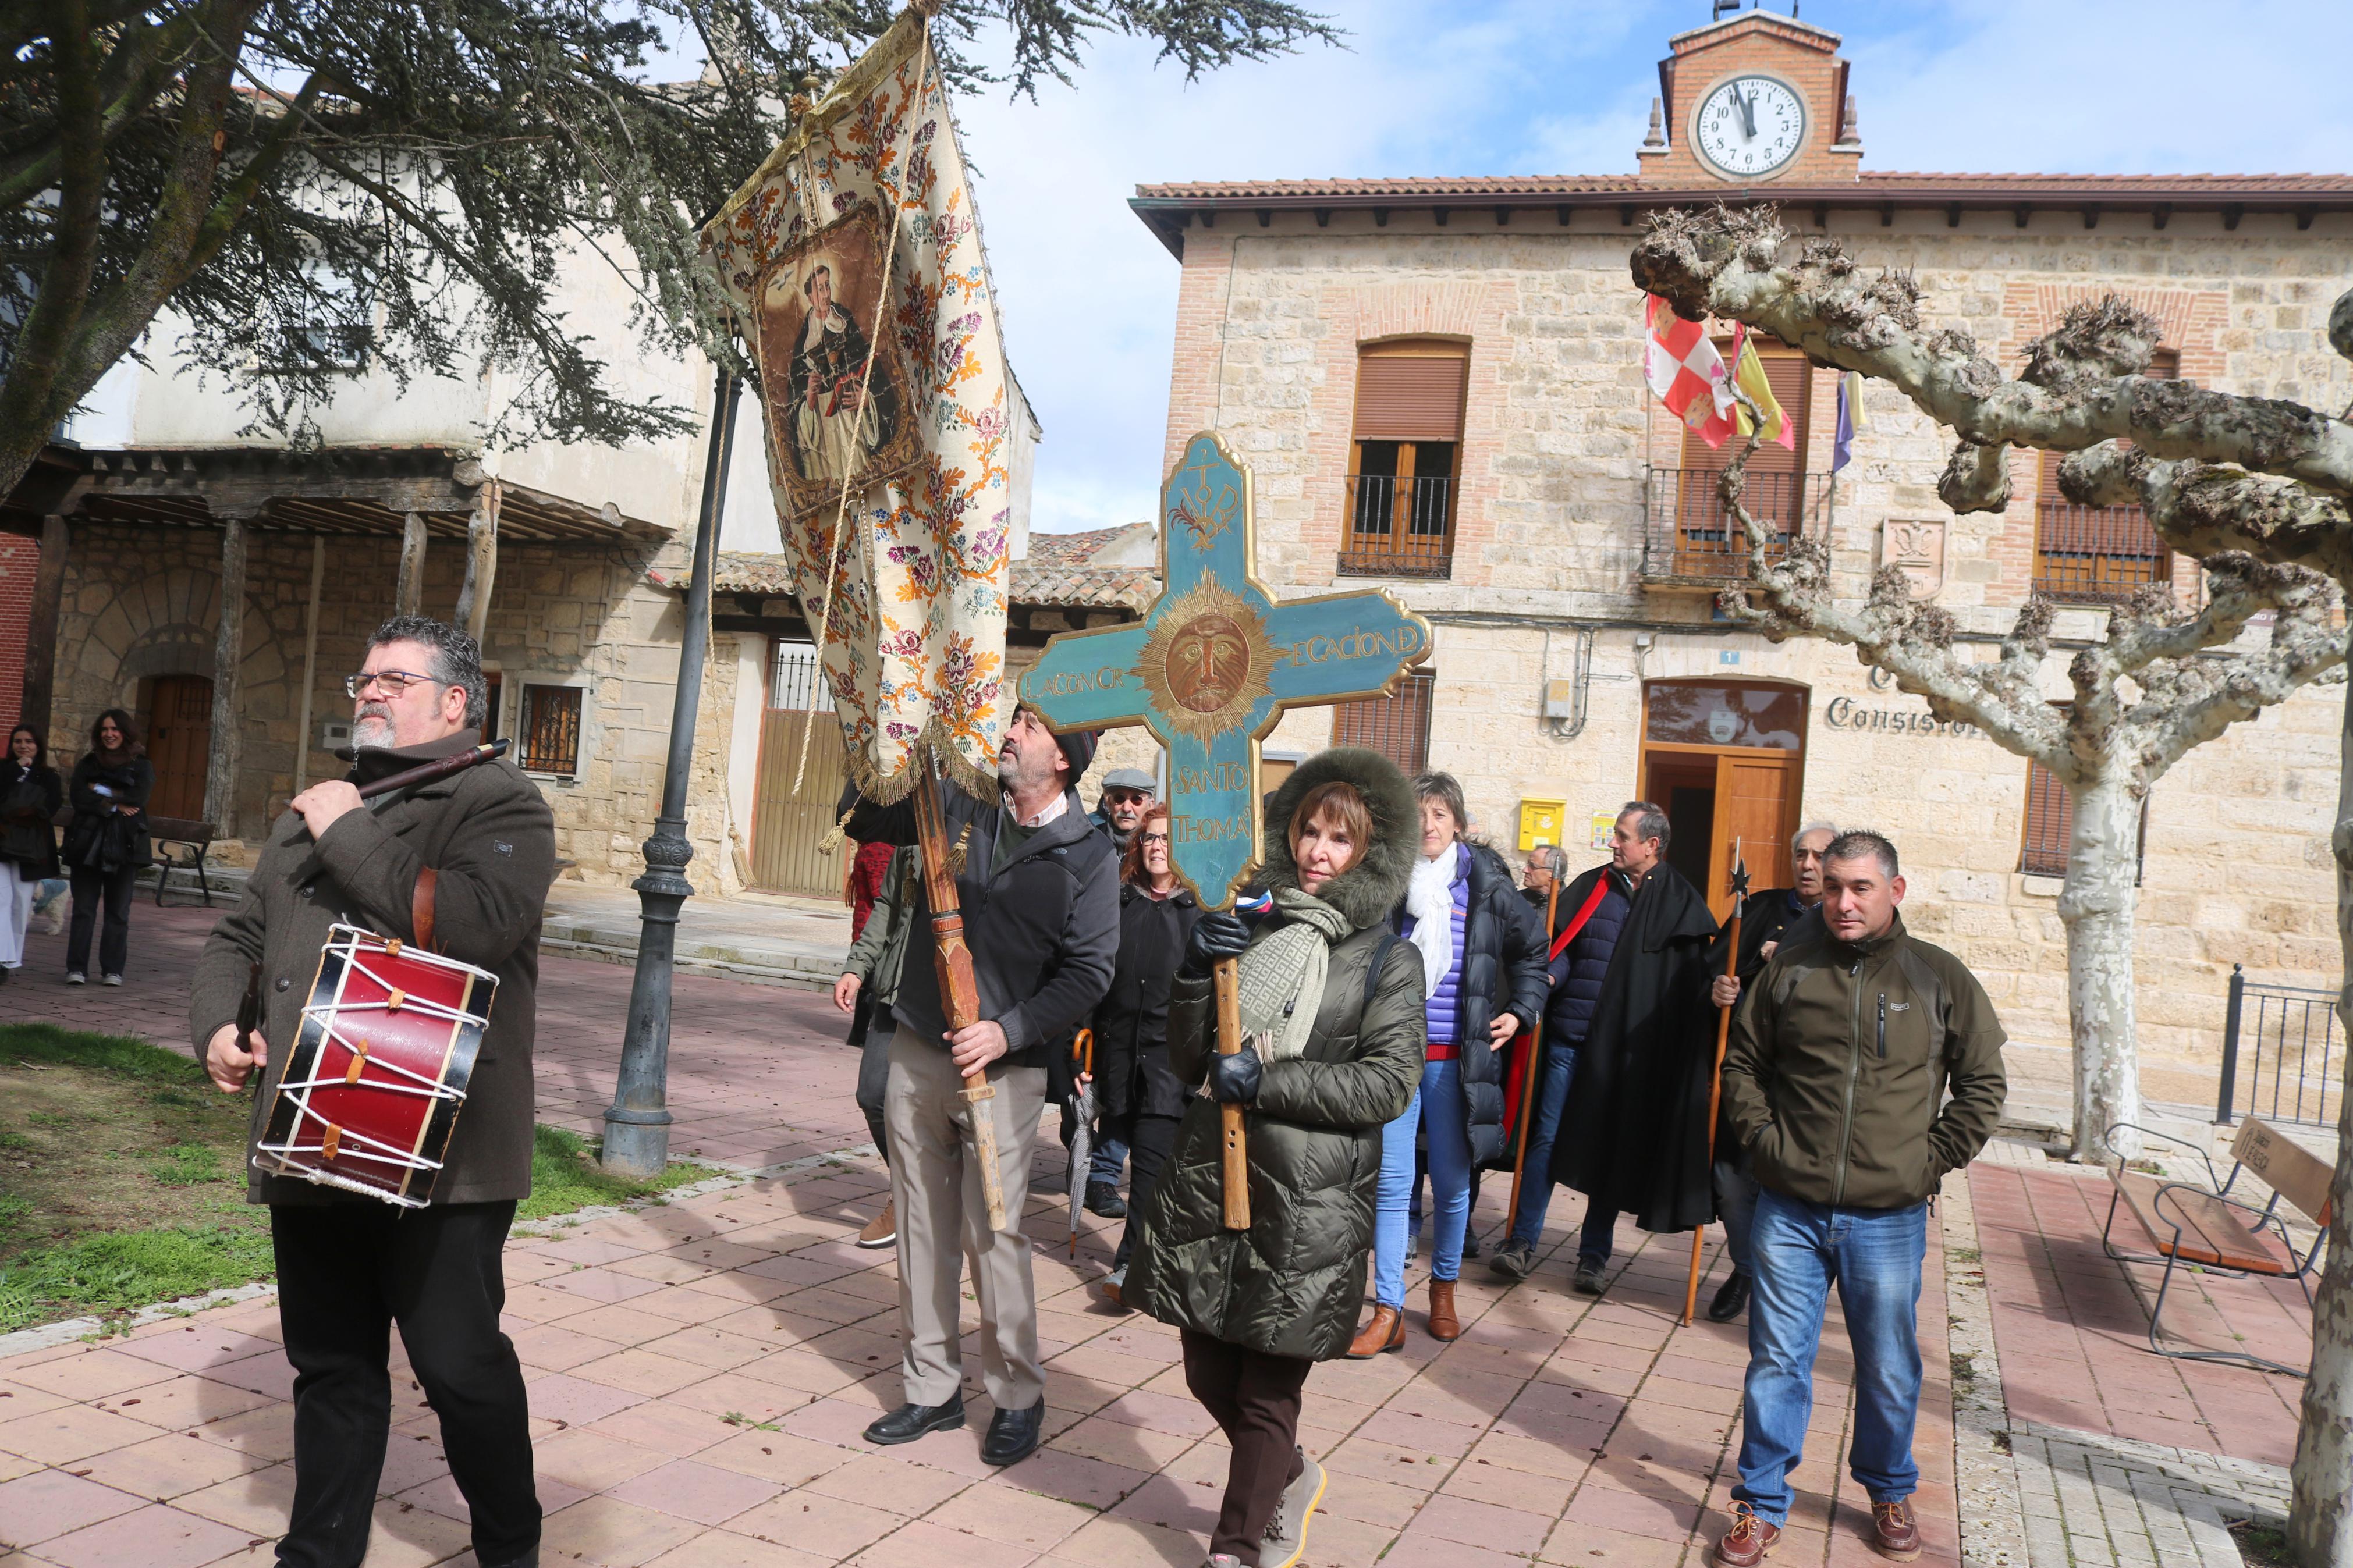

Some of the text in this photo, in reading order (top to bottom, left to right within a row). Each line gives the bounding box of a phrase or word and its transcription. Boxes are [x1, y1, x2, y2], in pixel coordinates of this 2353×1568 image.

[1730, 94, 1737, 105] 11
[1748, 88, 1759, 100] 12
[1717, 106, 1729, 118] 10
[1776, 104, 1784, 115] 2
[1711, 121, 1719, 132] 9
[1781, 120, 1790, 131] 3
[1717, 138, 1724, 149] 8
[1774, 137, 1783, 148] 4
[1729, 149, 1737, 159] 7
[1745, 153, 1753, 164] 6
[1764, 148, 1772, 159] 5
[1726, 652, 1732, 662] 1
[1174, 761, 1248, 794] SANTO
[1172, 805, 1251, 842] THOMAS
